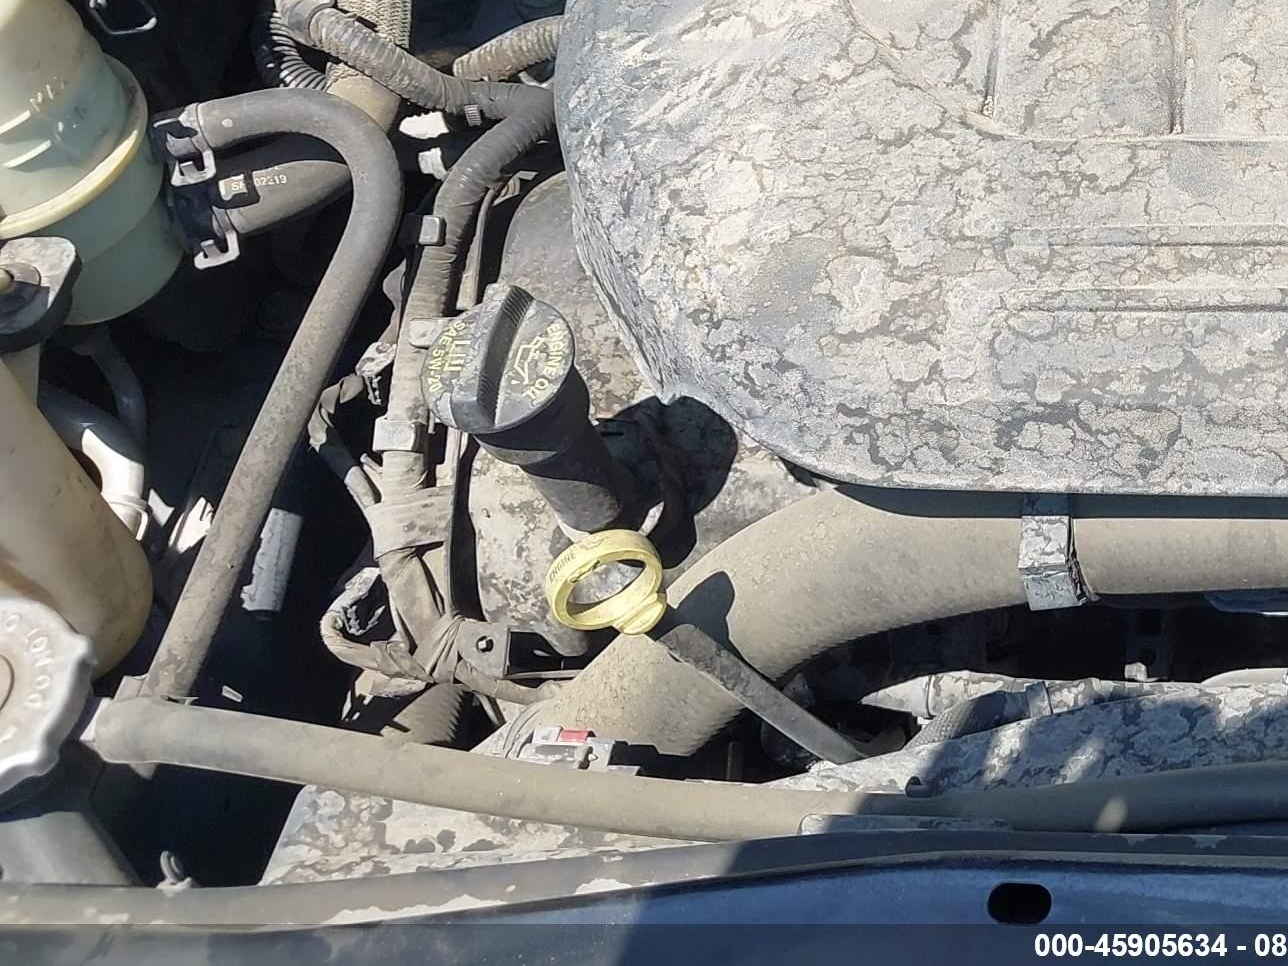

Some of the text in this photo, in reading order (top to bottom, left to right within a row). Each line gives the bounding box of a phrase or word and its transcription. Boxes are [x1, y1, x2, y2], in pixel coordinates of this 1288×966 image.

[427, 321, 466, 393] SAE 5W-20
[543, 318, 570, 379] ENGINE
